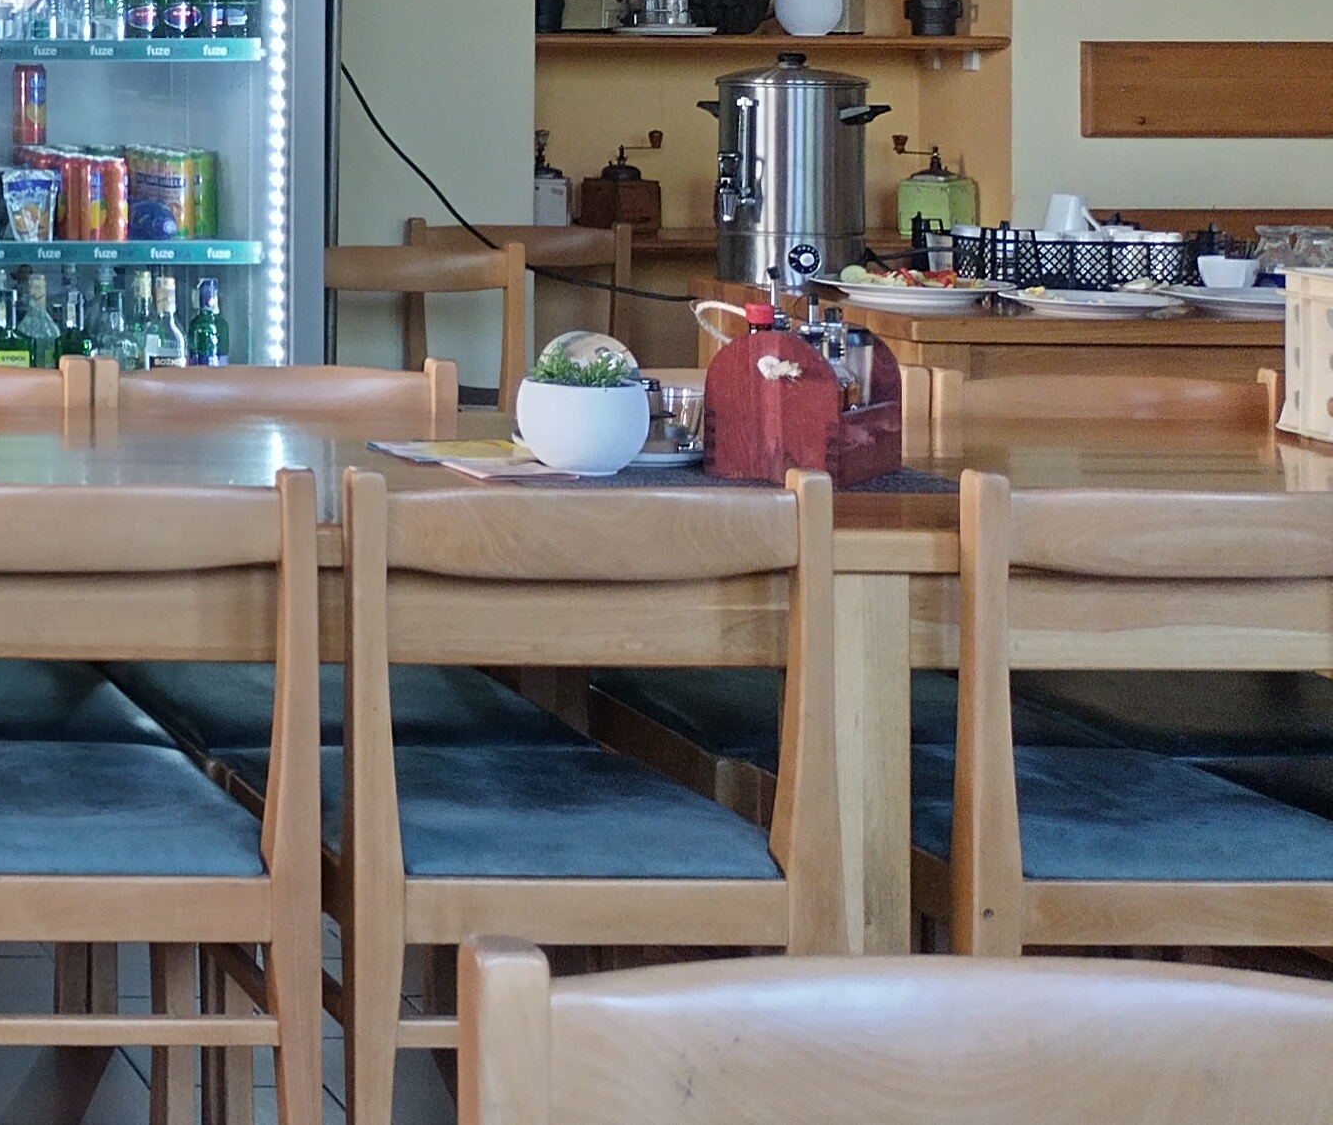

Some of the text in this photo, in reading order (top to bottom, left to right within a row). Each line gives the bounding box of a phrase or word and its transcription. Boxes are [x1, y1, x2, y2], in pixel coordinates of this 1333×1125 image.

[33, 44, 228, 56] fuze fuze fuze fuze
[37, 248, 61, 259] fuze
[94, 248, 118, 259] fuze
[150, 248, 175, 260] fuze
[207, 248, 232, 260] fuze
